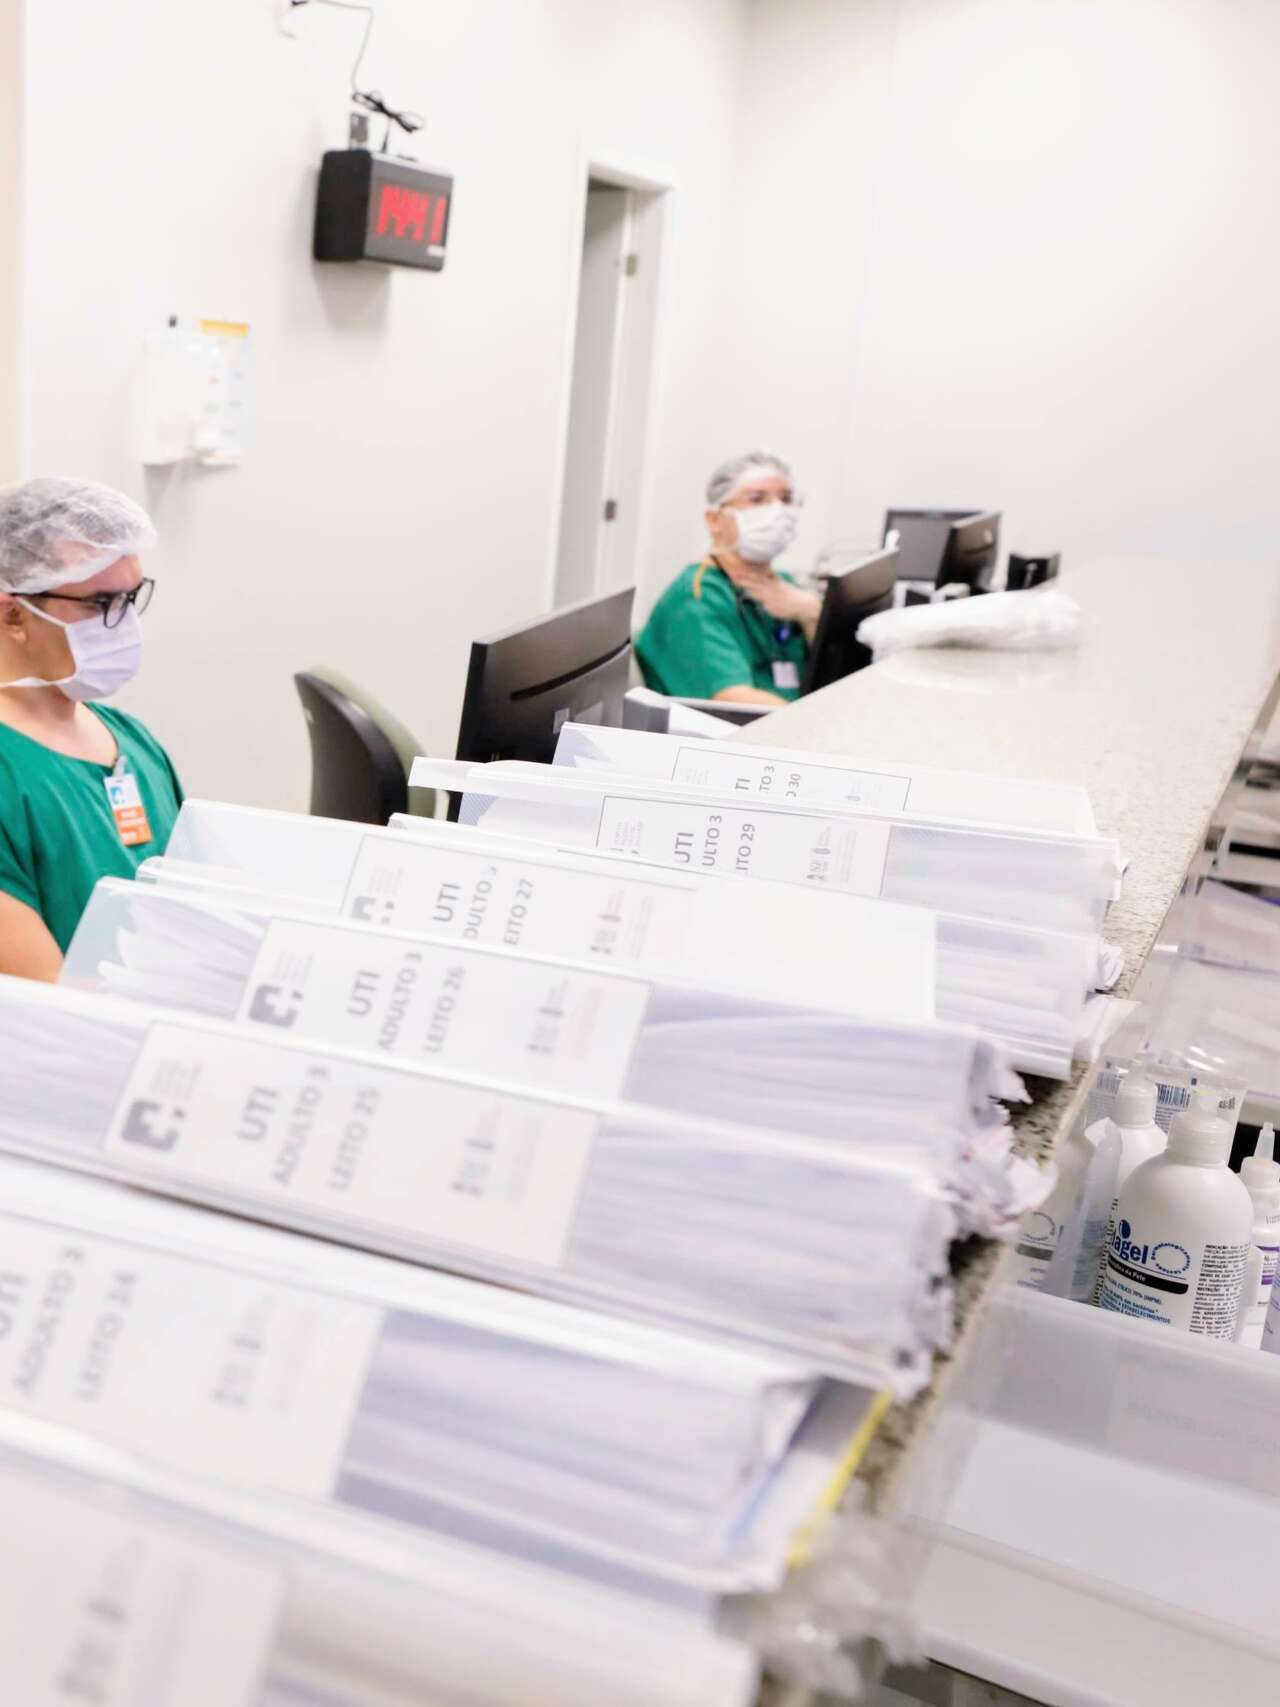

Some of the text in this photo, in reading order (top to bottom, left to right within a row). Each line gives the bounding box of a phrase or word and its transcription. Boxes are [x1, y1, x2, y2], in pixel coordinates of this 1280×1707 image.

[734, 777, 751, 791] TI
[765, 765, 775, 774] 3
[788, 773, 801, 789] 30
[674, 832, 695, 864] UTI
[702, 815, 723, 867] ULTO 3
[735, 823, 756, 871] ITO 29
[432, 882, 462, 923] UTI
[463, 879, 494, 940] DULTO
[503, 878, 535, 946] EITO 27
[347, 969, 381, 1017] UTI
[377, 967, 417, 1052] ADULTO
[423, 966, 467, 1054] LEITO 26
[236, 1085, 279, 1142] UTI
[272, 1085, 323, 1186] ADULTO
[327, 1119, 369, 1192] LEITO
[12, 1268, 76, 1396] ADULTO
[75, 1310, 125, 1403] LEITO
